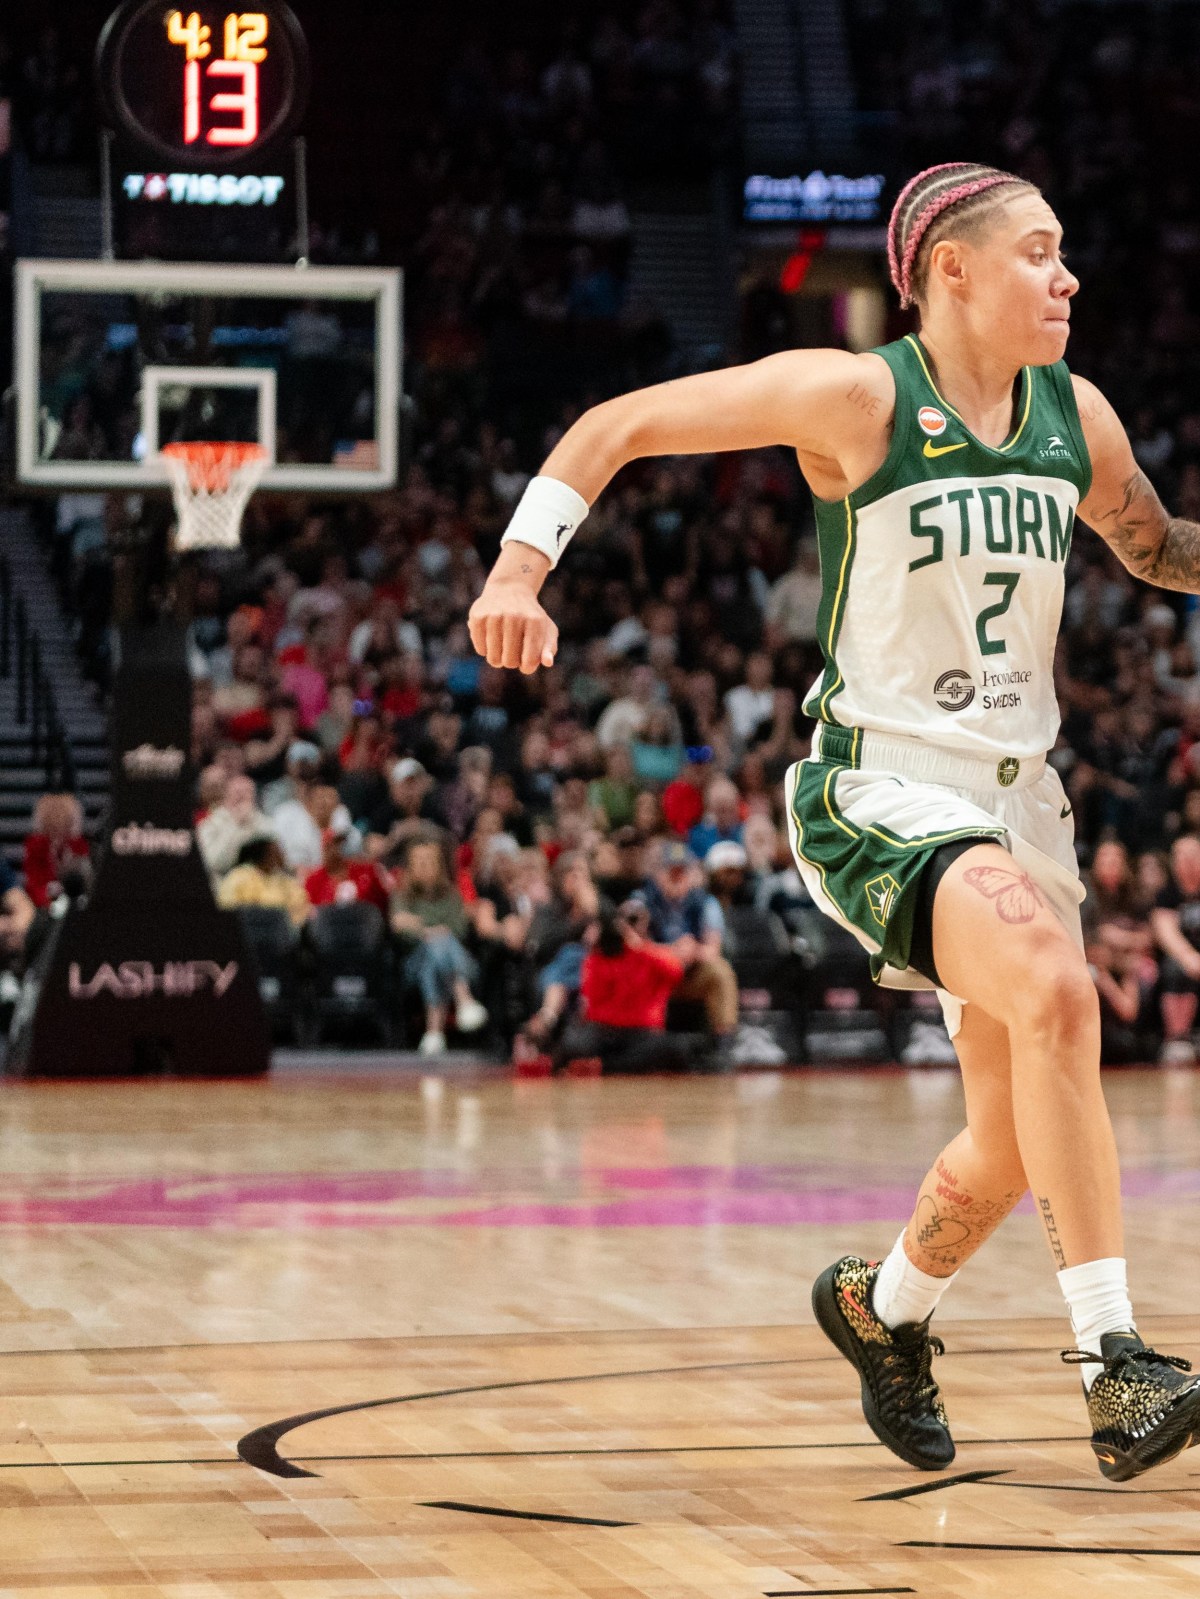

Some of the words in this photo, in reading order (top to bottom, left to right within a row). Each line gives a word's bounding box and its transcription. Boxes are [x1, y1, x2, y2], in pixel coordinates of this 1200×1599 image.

[167, 10, 269, 63] 4:12
[183, 58, 260, 147] 13
[166, 173, 285, 205] TISSOT
[909, 486, 1074, 573] STORM
[976, 572, 1021, 656] 2
[68, 959, 240, 998] LASHIFY
